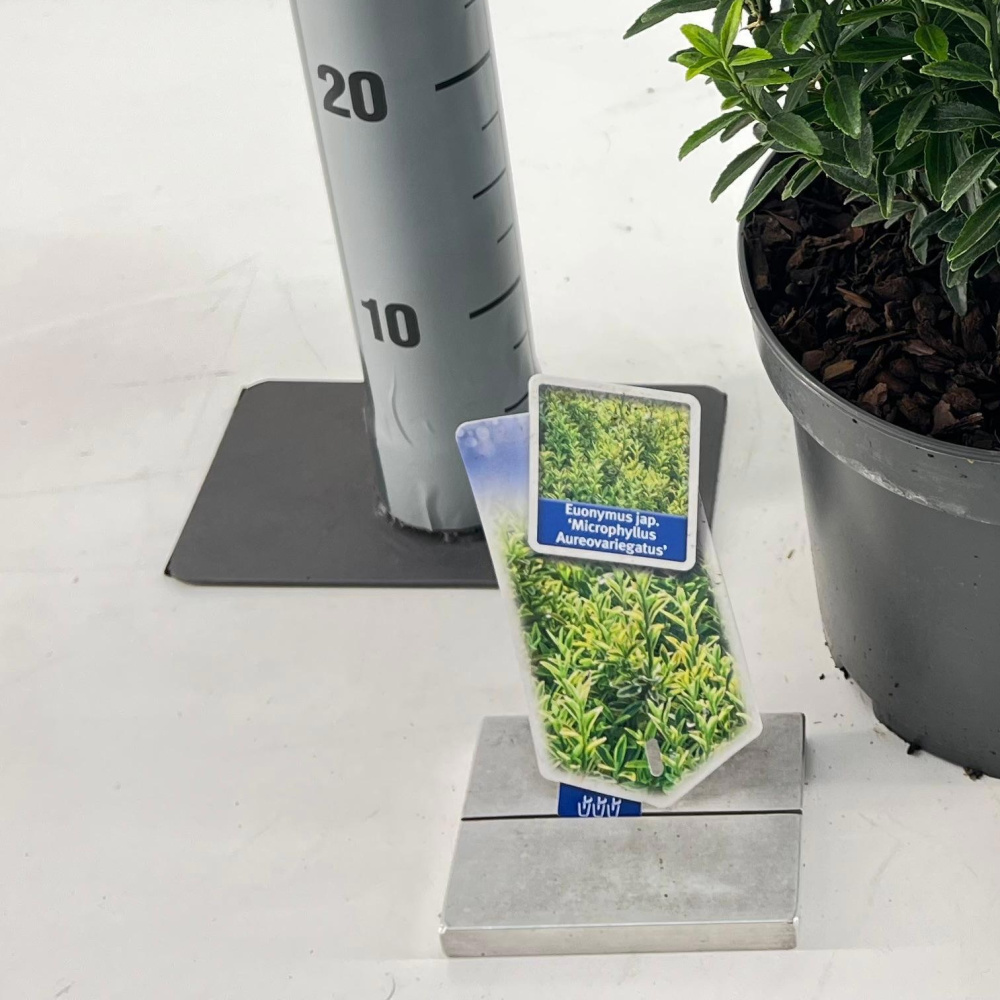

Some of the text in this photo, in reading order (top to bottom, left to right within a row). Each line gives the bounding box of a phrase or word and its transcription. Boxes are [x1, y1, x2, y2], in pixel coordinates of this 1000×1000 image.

[317, 64, 388, 123] 20
[361, 298, 421, 348] 10
[565, 503, 660, 527] Euonymus jap.
